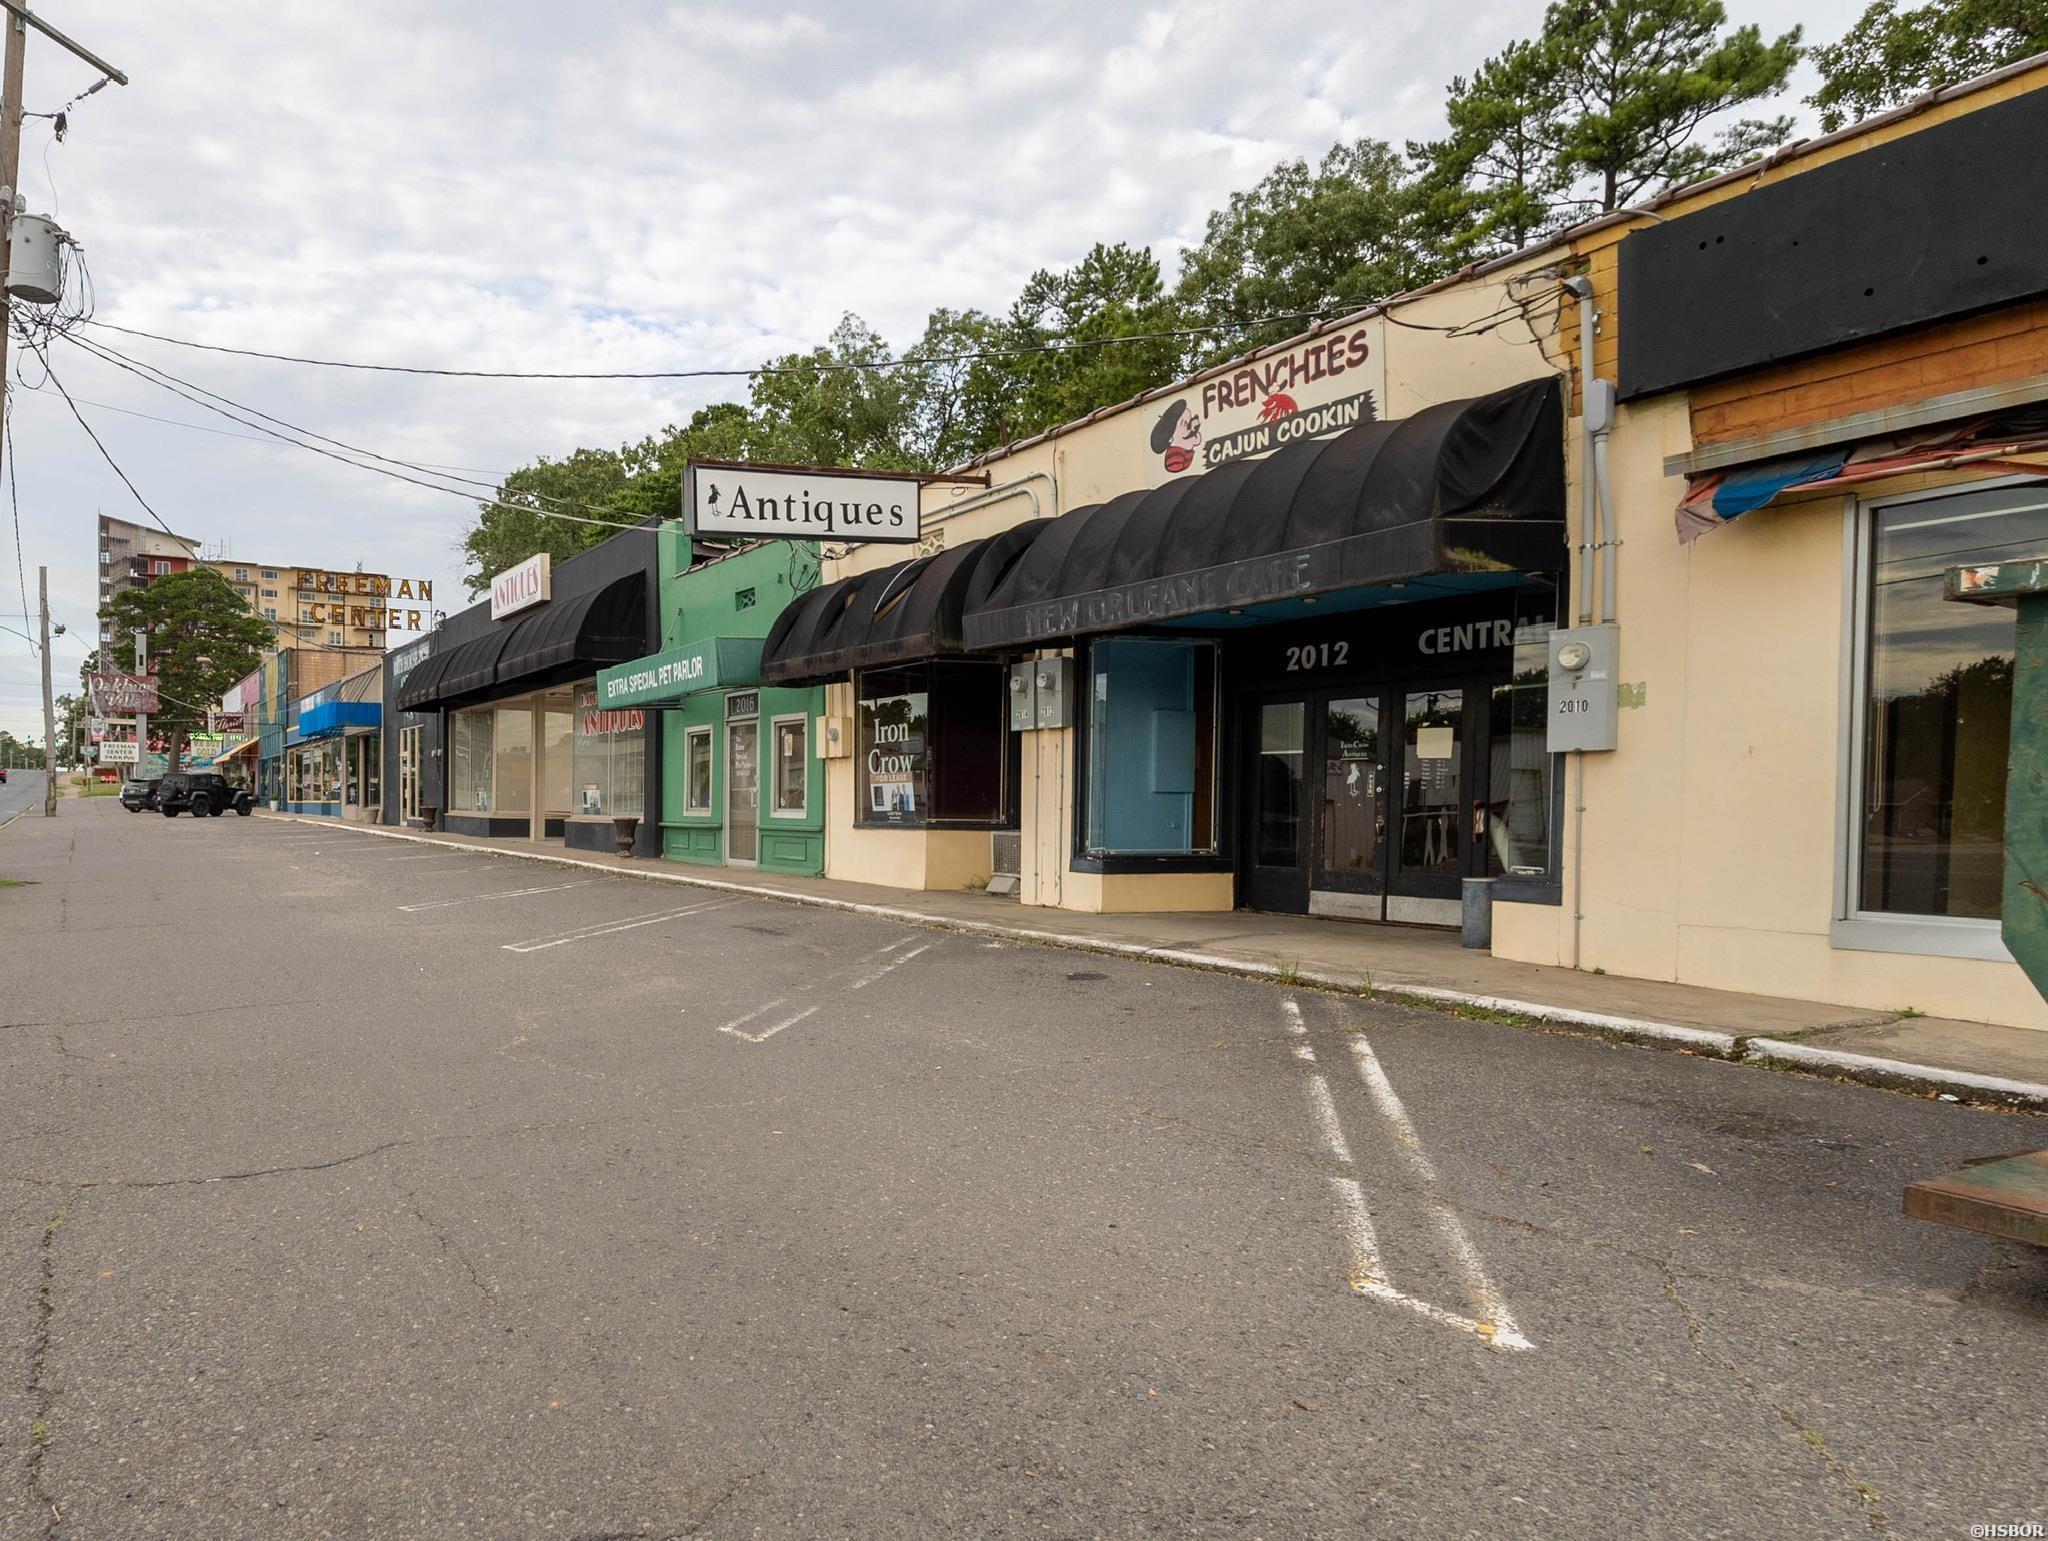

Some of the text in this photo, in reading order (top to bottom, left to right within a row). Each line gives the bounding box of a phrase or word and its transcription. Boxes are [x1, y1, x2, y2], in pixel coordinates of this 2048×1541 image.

[1202, 329, 1369, 420] FRENCHIES
[1208, 395, 1366, 464] CAJUN COOKIN'
[726, 485, 904, 533] Antiques
[297, 571, 432, 600] FREEMAN
[311, 603, 421, 631] CENTER
[1286, 641, 1349, 671] 2012
[607, 656, 703, 698] EXTRA SPECIAL PET PARLOR
[736, 697, 755, 712] 2016
[1559, 699, 1588, 713] 2010
[582, 710, 644, 736] ANTIQUES
[873, 718, 911, 744] Iron
[868, 748, 914, 774] Crow
[889, 773, 907, 782] LEASE
